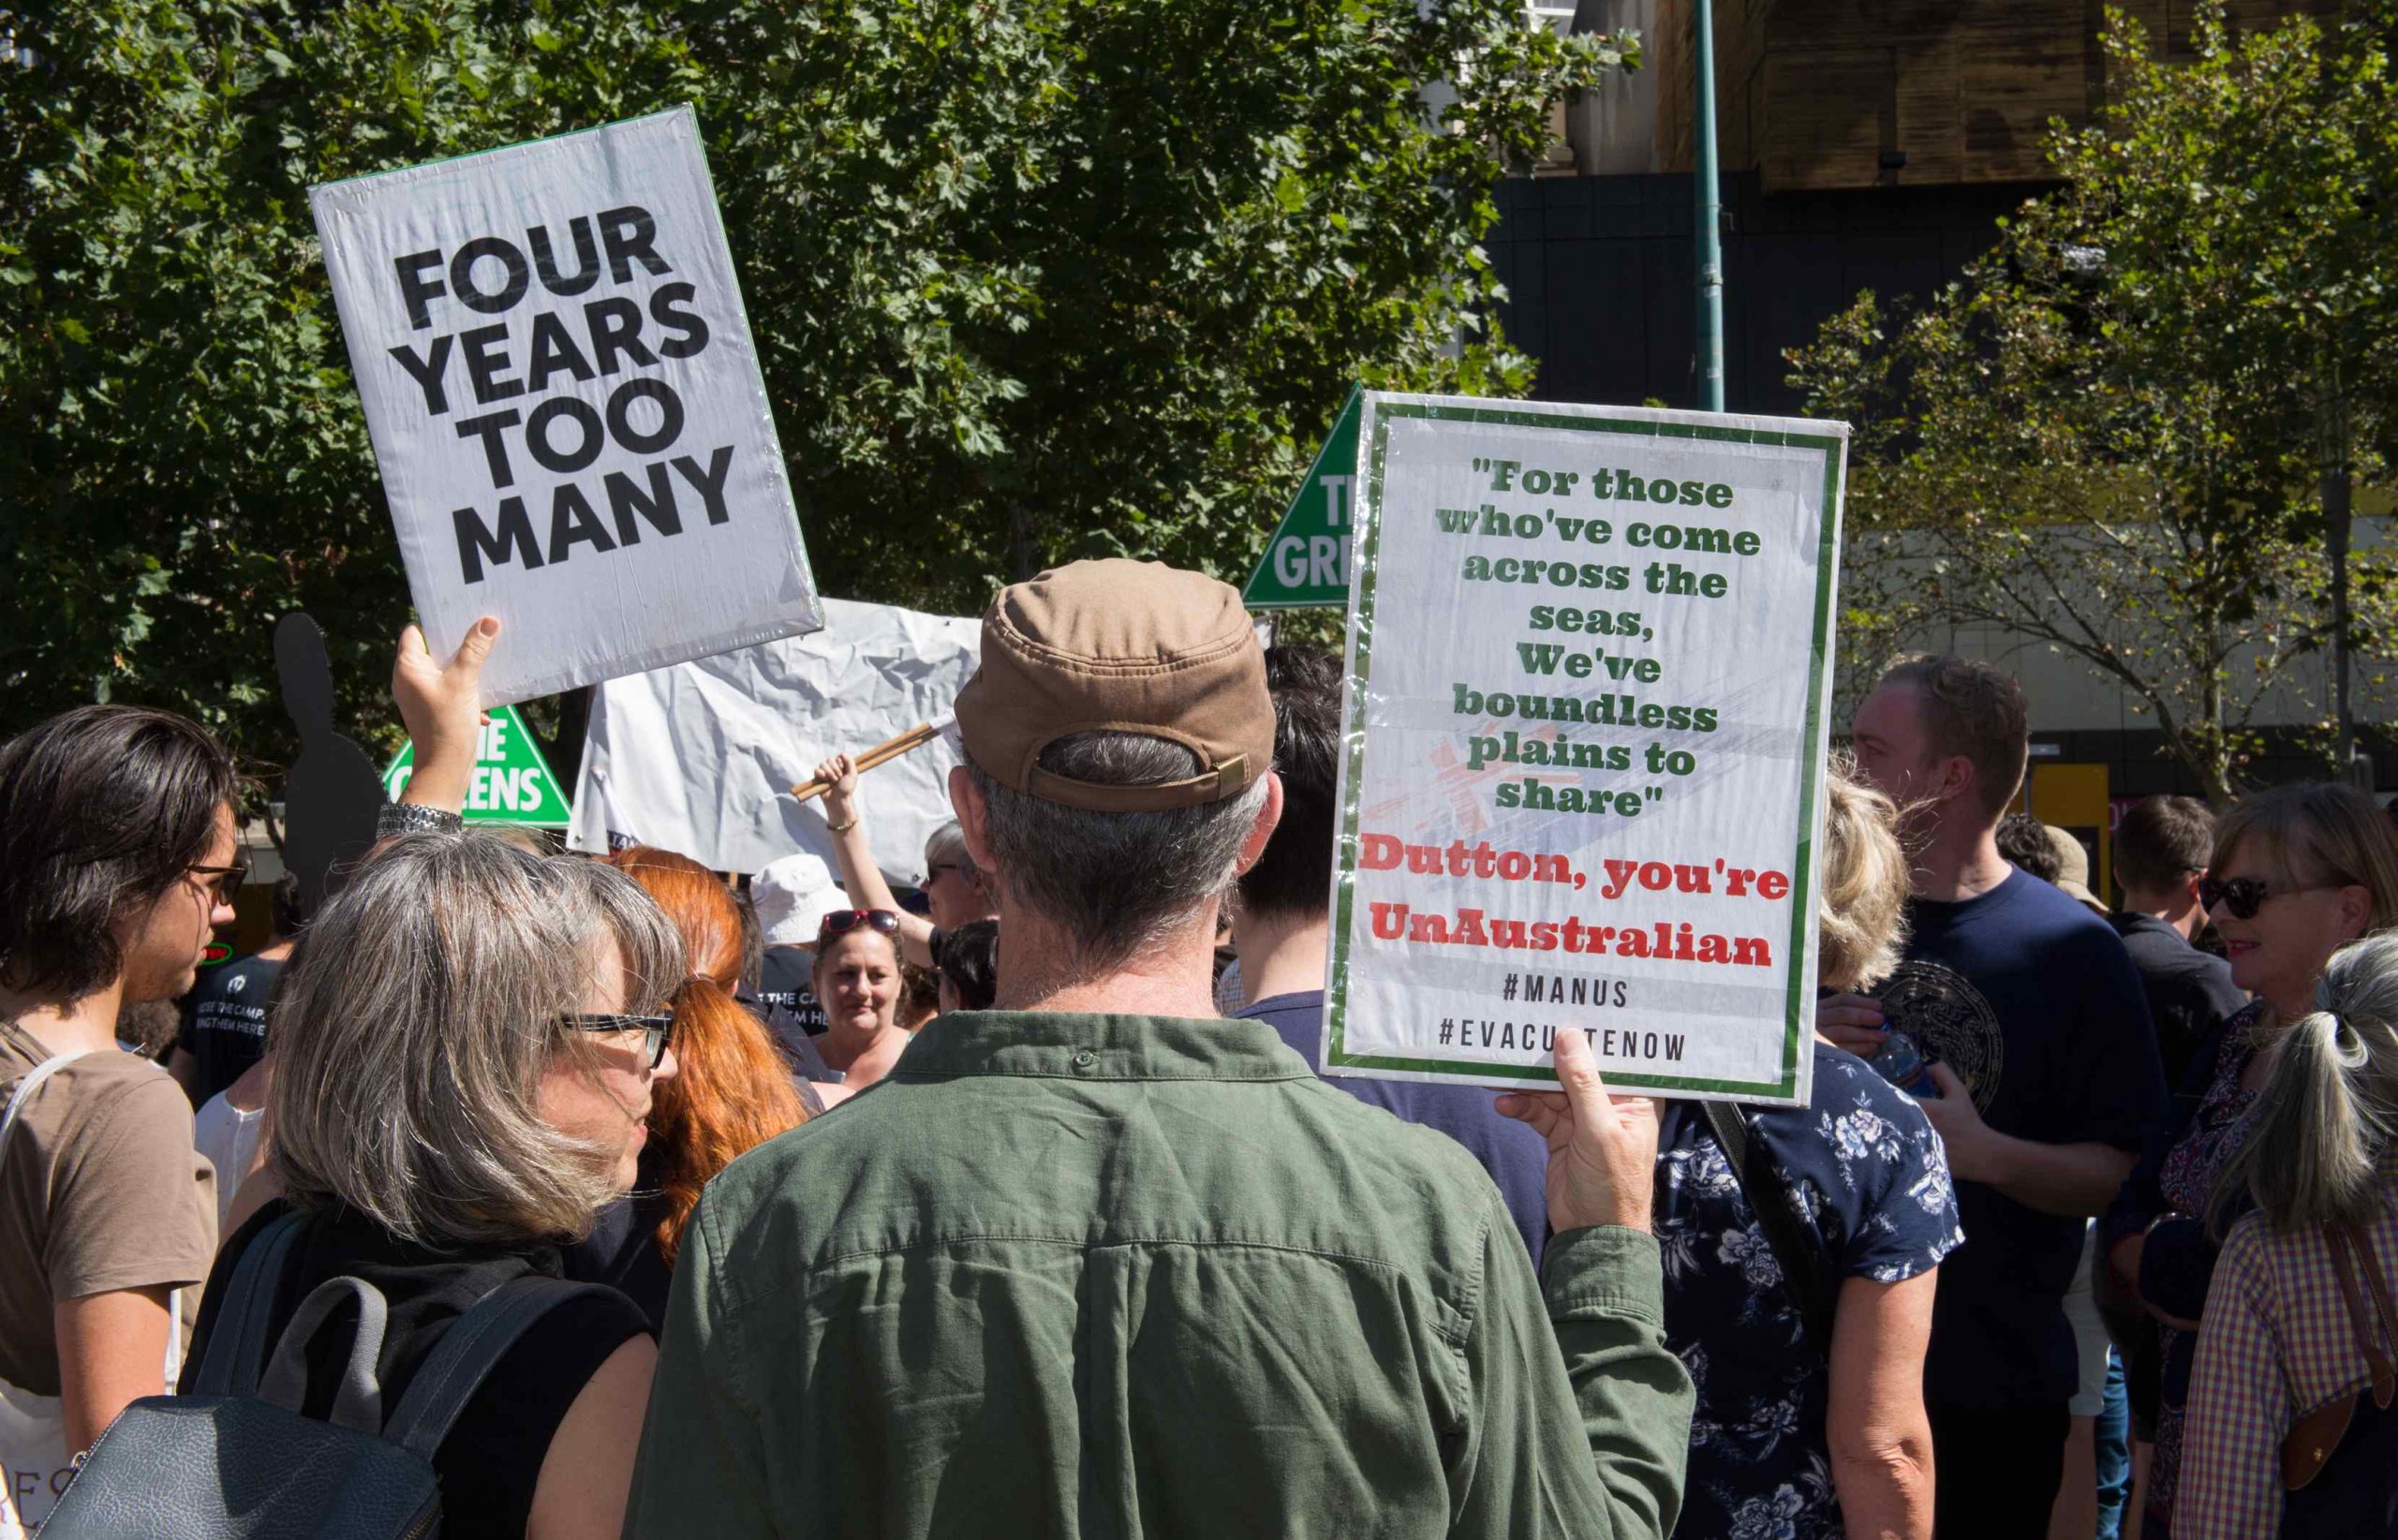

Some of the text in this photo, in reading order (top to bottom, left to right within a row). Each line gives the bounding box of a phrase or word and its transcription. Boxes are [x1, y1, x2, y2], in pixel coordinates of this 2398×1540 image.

[393, 205, 673, 331] FOUR
[388, 282, 710, 416] YEARS
[455, 378, 685, 490] TOO
[1472, 457, 1733, 509] "For those
[451, 446, 734, 585] MANY
[1435, 506, 1761, 556] who've come
[1463, 555, 1728, 599] across the
[1529, 604, 1654, 643] seas,
[1516, 642, 1662, 684] We've
[1452, 683, 1718, 733] boundless
[1467, 731, 1696, 776] plains to
[1495, 777, 1664, 818] share"
[1359, 832, 1789, 900] Dutton, you're
[1369, 901, 1772, 967] UnAustralian
[767, 992, 795, 1005] THE
[1502, 972, 1628, 1008] #MANUS
[236, 1020, 266, 1037] HERE
[1439, 1017, 1685, 1061] #EVACUTENOW
